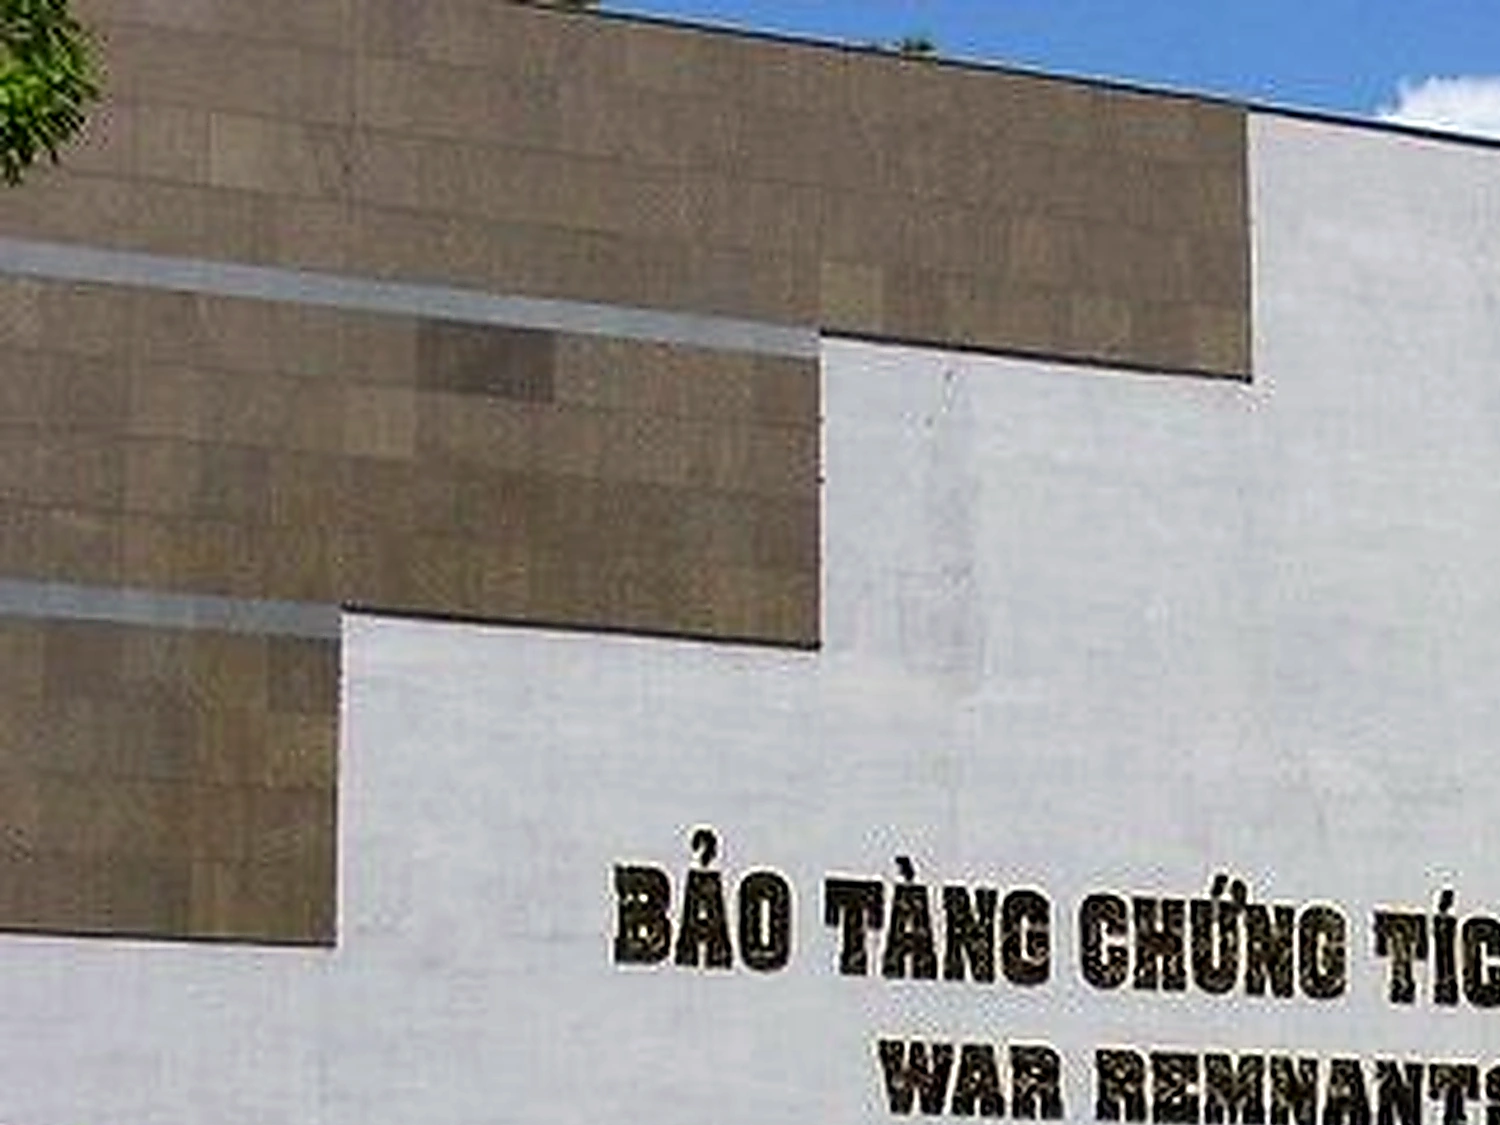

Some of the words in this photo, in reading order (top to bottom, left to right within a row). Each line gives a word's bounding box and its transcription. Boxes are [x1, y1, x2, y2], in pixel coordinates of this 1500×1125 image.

[613, 829, 791, 973] BẢO
[824, 856, 1051, 988] TÀNG
[1078, 874, 1347, 1001] CHỨNG
[879, 1039, 1064, 1121] WAR
